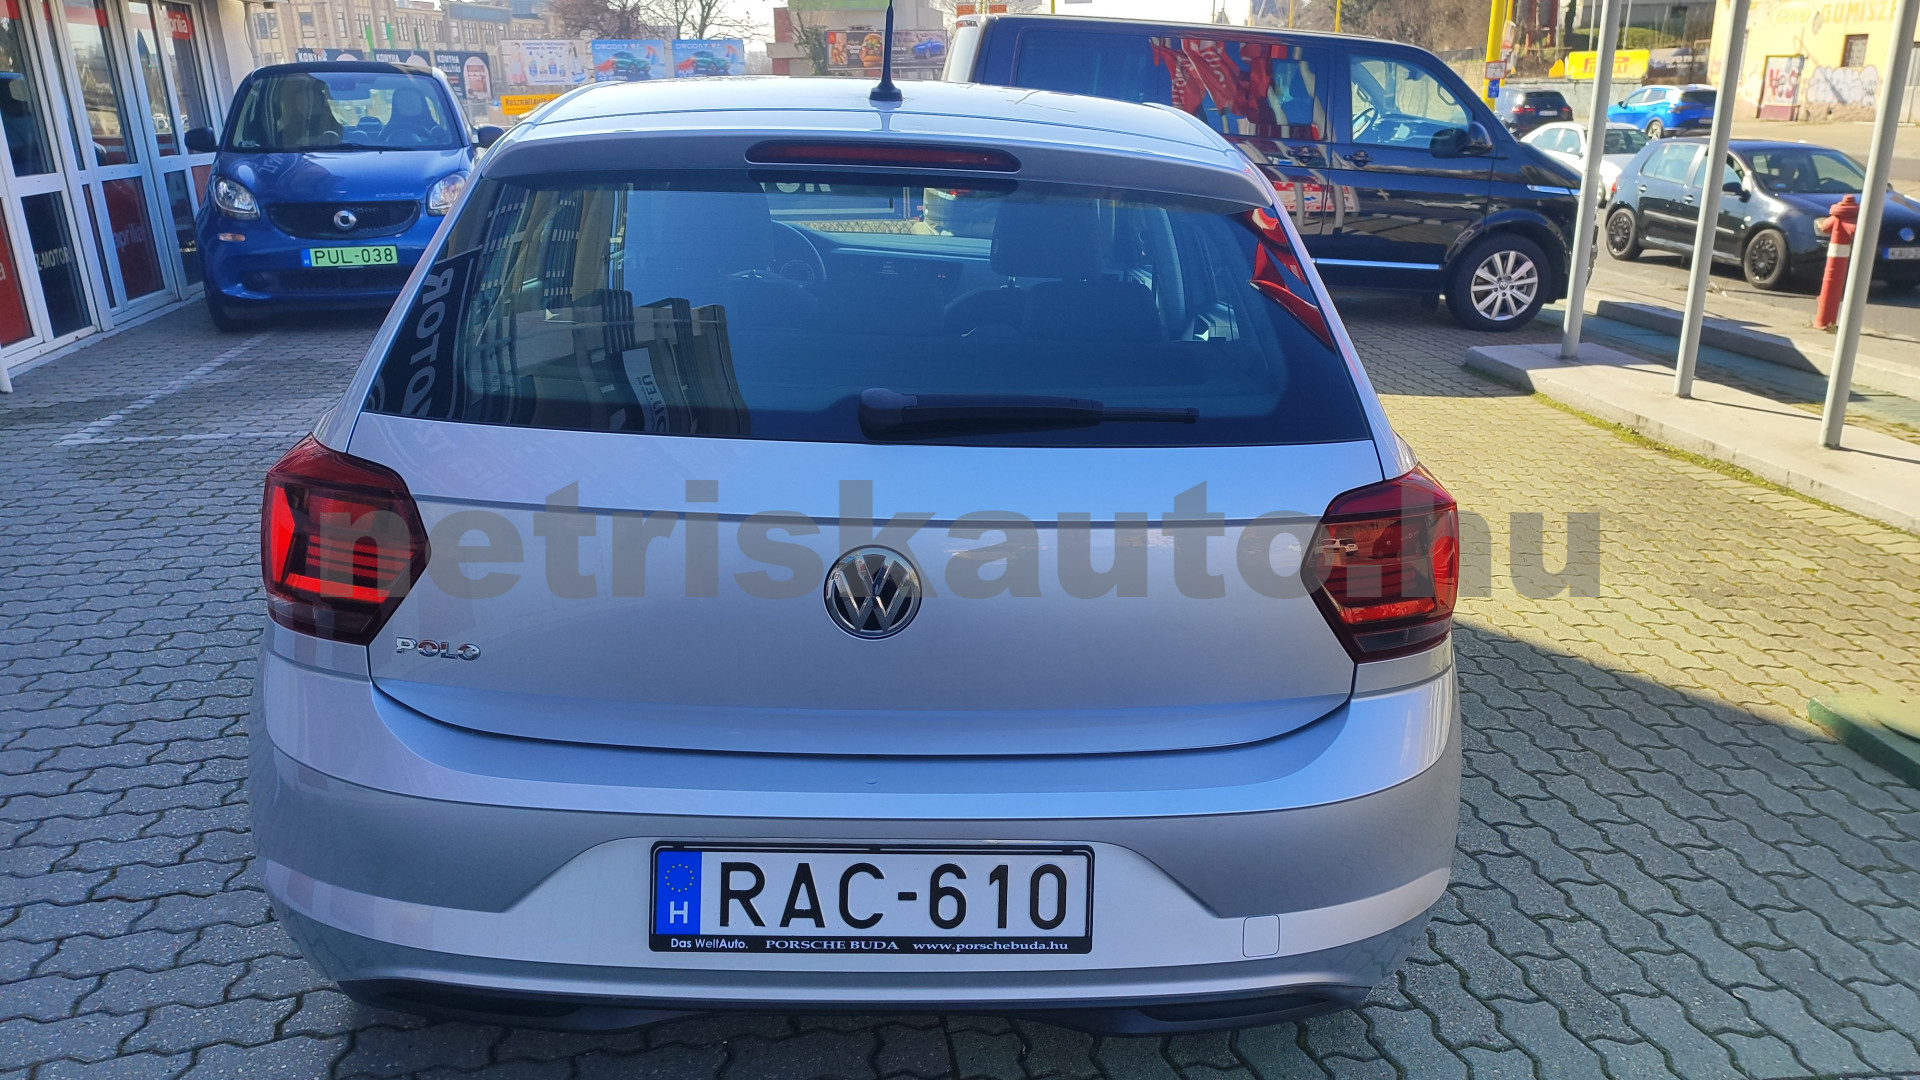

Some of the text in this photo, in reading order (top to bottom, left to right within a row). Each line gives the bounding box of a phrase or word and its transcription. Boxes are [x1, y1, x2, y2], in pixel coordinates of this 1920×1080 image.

[314, 248, 393, 265] PUL-038
[396, 637, 481, 661] POLO
[669, 862, 1067, 930] H RAC-610
[670, 938, 1069, 952] Das WeltAuto. PORSCHE BUDA www.porschebuda.hu
